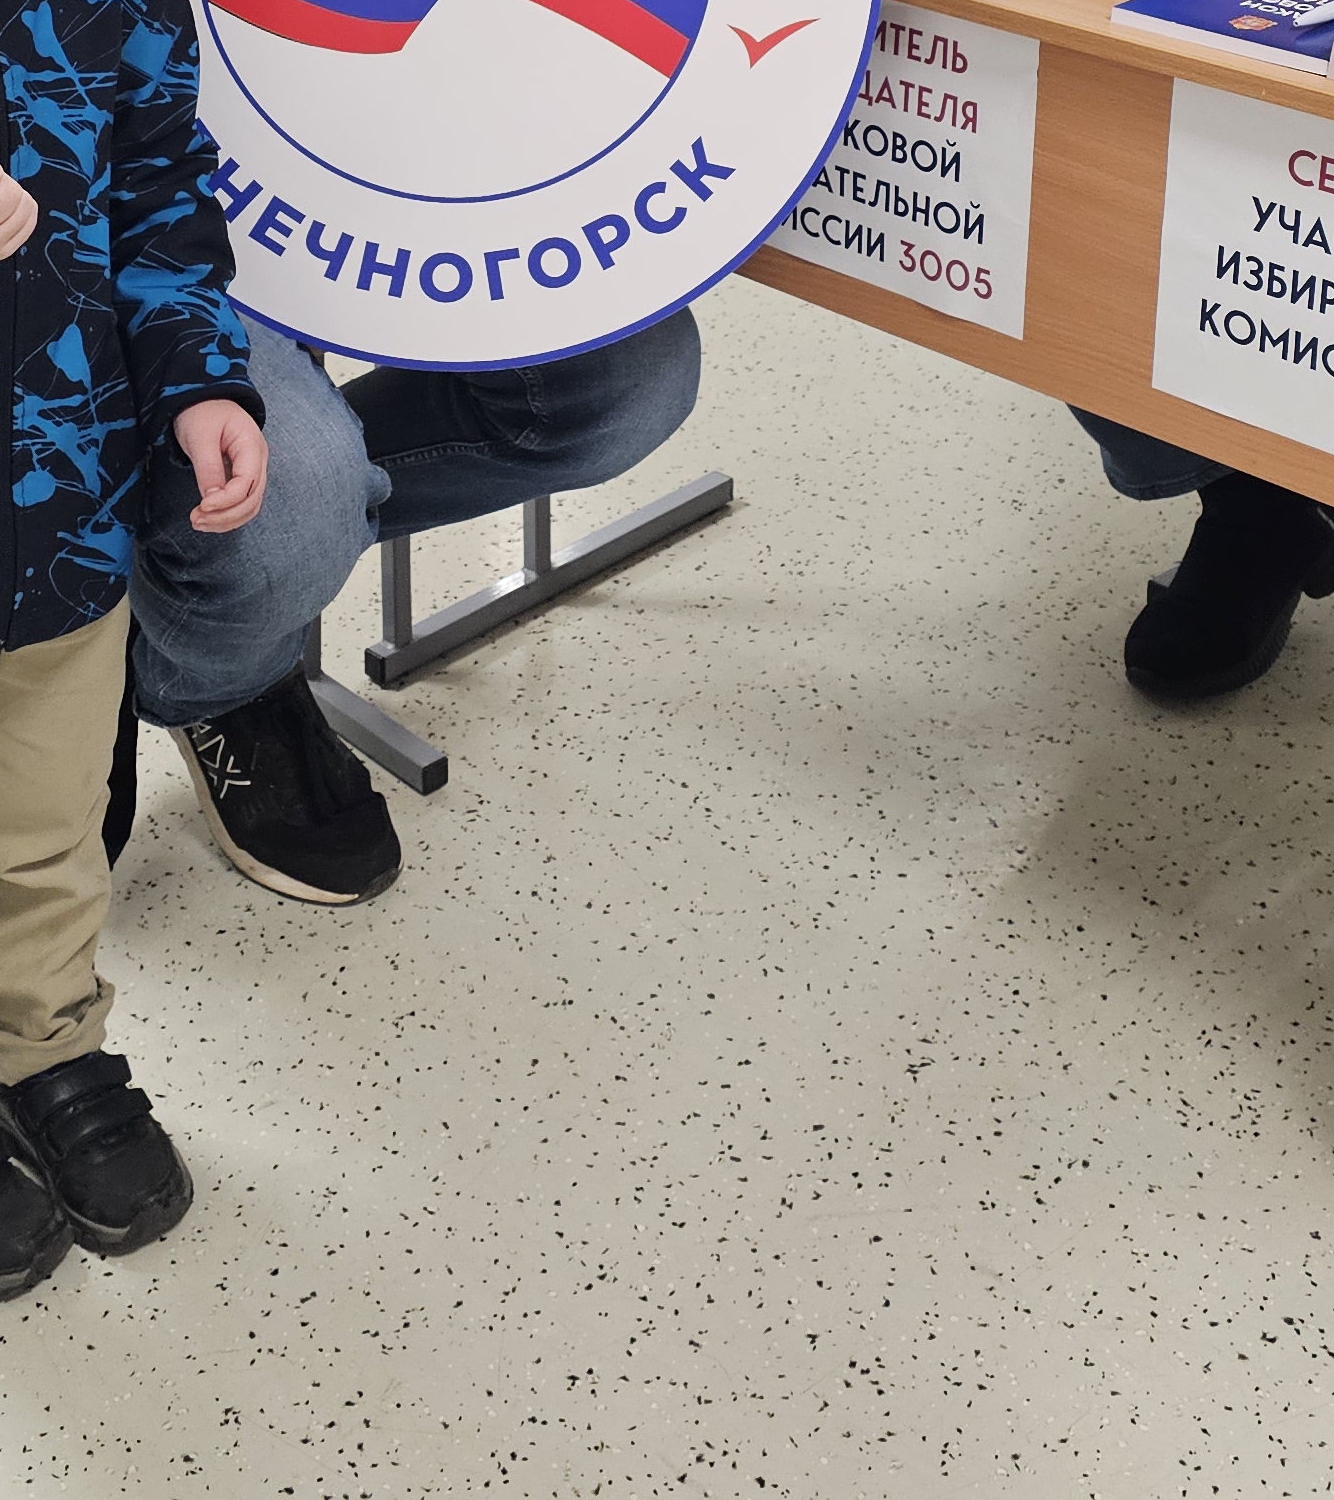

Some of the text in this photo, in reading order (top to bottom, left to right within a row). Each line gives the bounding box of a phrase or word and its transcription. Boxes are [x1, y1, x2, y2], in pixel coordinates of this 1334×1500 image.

[1239, 0, 1304, 19] АКОН
[874, 20, 968, 74] ИТЕЛЬ
[857, 70, 978, 134] ДАТЕЛЯ
[843, 119, 961, 183] КОВОЙ
[197, 118, 737, 303] НЕЧНОГОРСК
[812, 164, 985, 245] АТЕЛЬНОЙ
[781, 205, 993, 300] ИССИИ 3005
